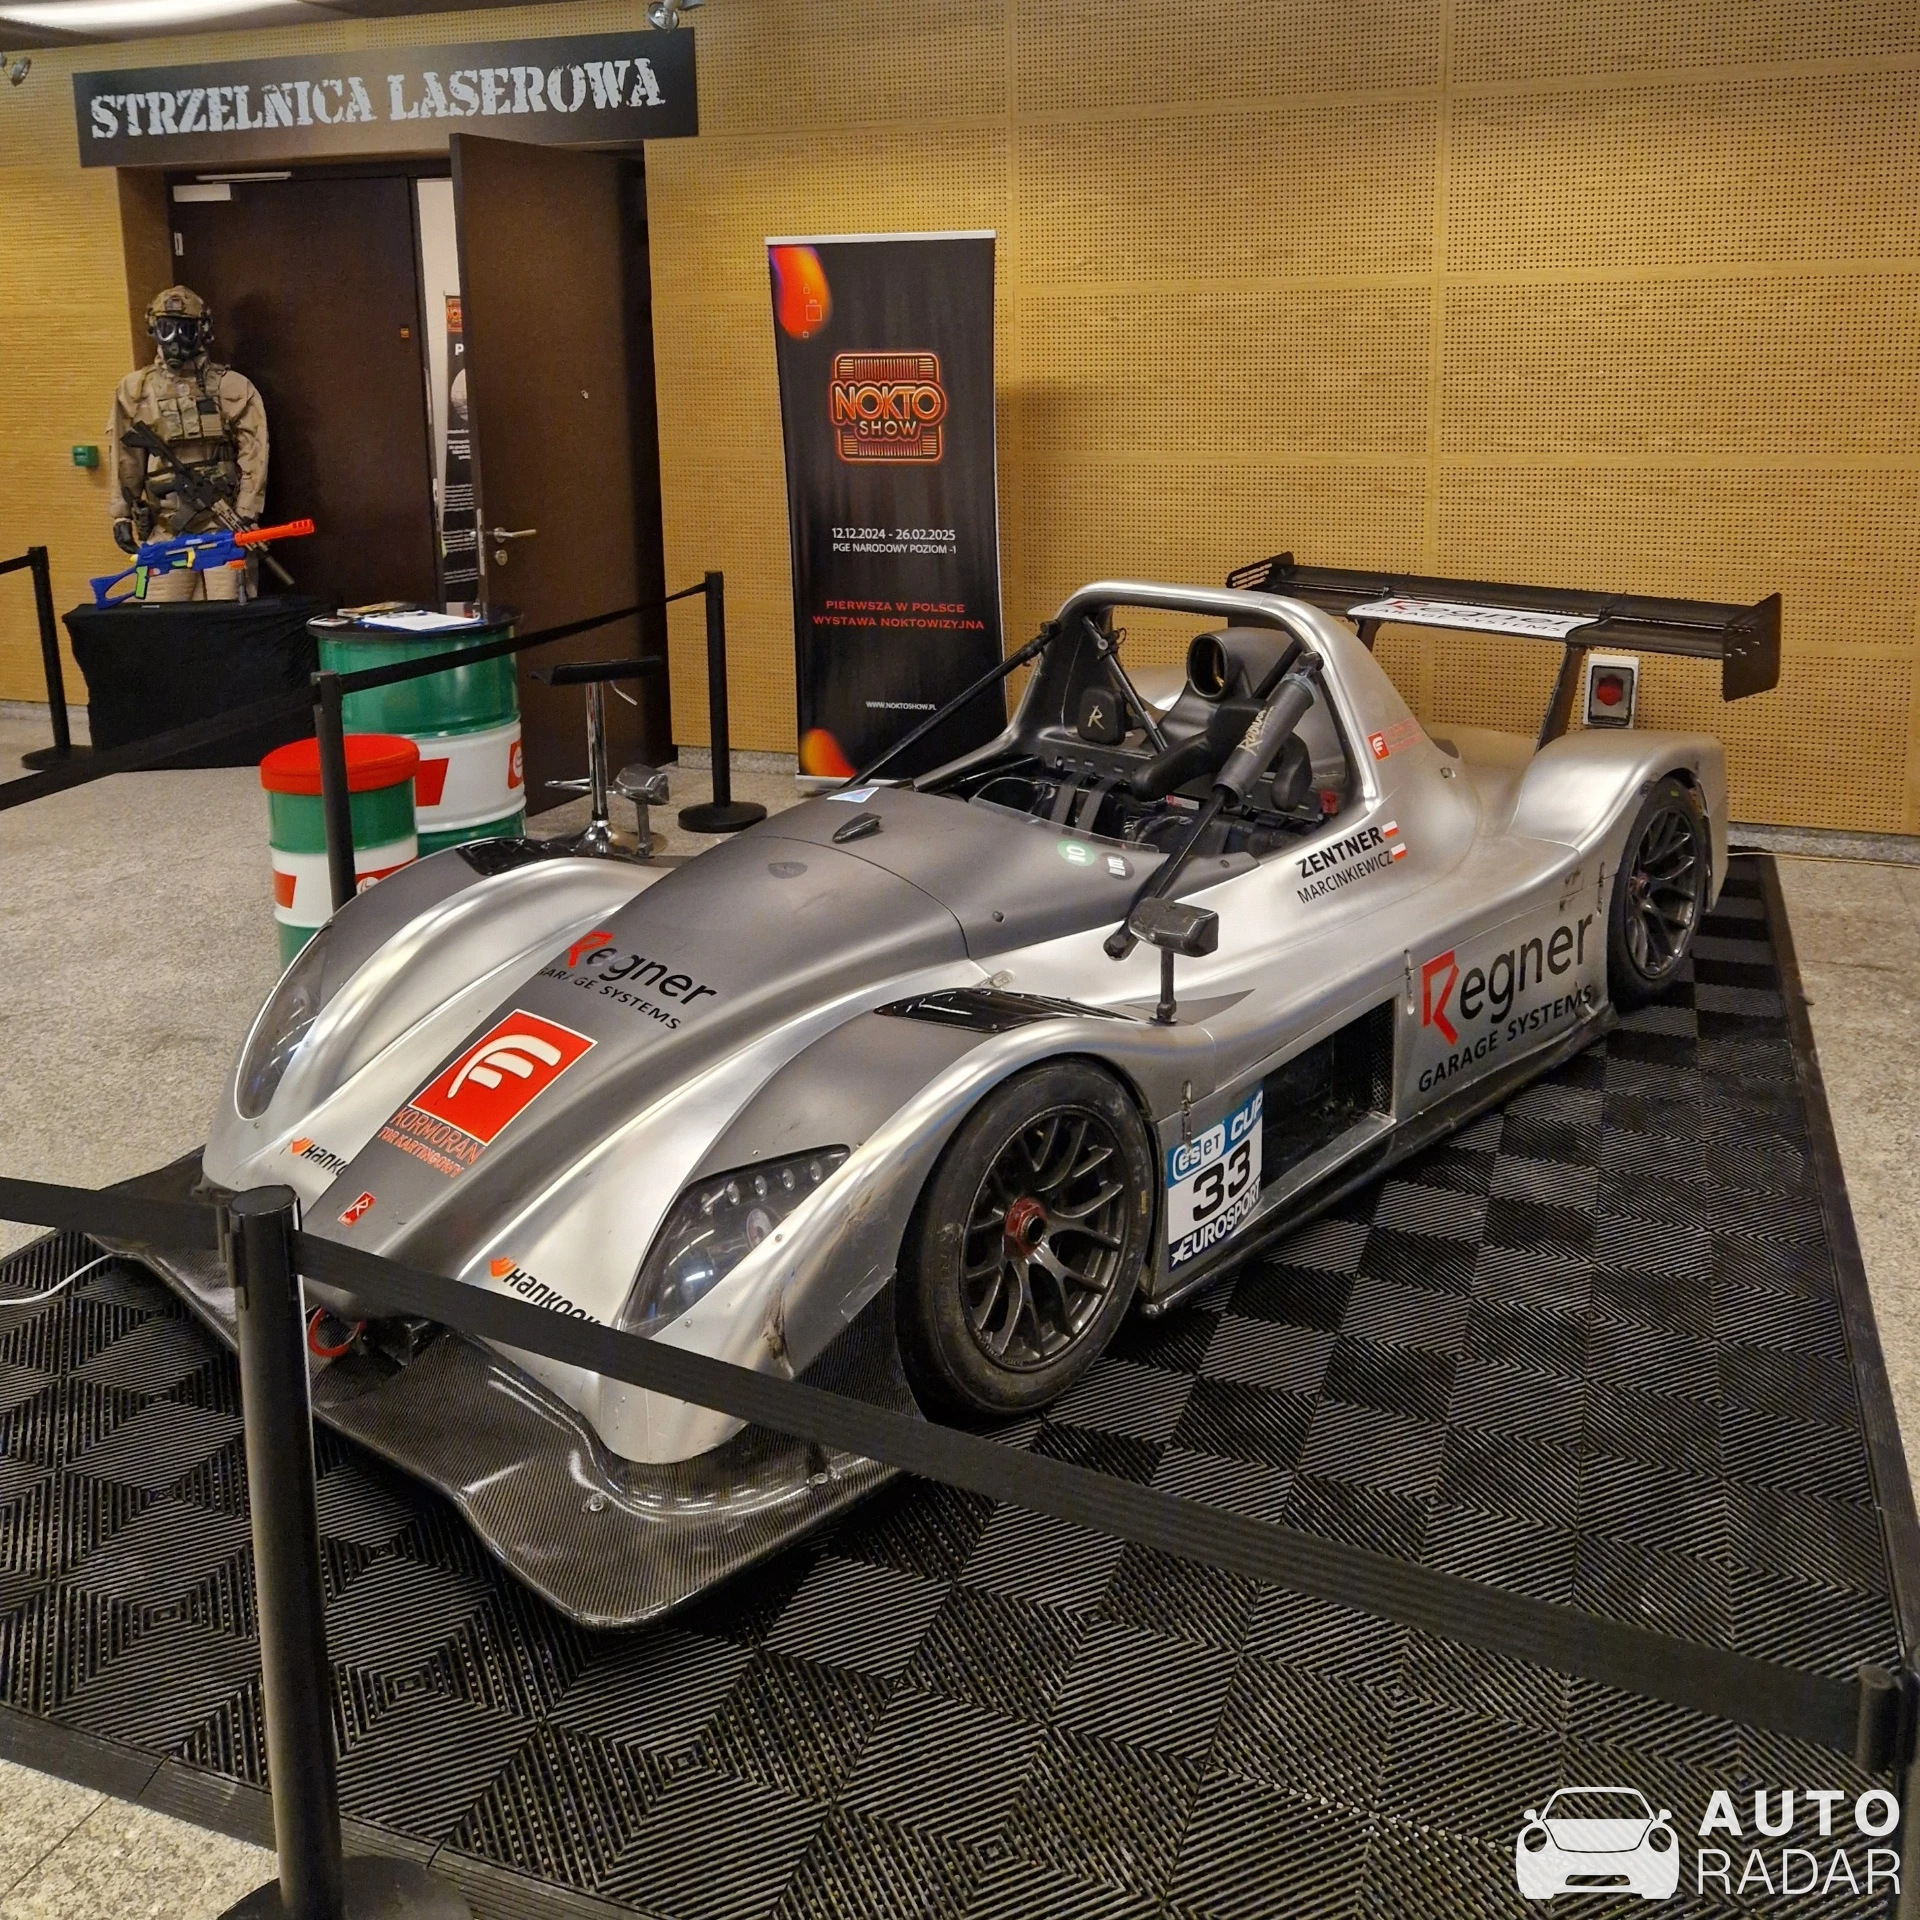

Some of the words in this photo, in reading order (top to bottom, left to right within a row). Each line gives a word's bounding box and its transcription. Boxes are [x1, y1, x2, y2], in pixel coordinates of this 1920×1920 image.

[91, 75, 377, 138] STRZELNICA
[387, 57, 667, 121] LASEROWA
[834, 385, 942, 421] NOKTO
[858, 420, 917, 436] SHOW
[831, 527, 886, 540] 12.12.2024
[895, 528, 956, 541] 26.02.2025
[832, 542, 851, 552] PGE
[852, 543, 908, 553] NARODOWY
[909, 544, 947, 554] POZIOM
[949, 545, 957, 555] -1
[812, 616, 877, 627] WYSTAWA
[880, 617, 985, 630] NOKTOWIZYJNA
[825, 600, 892, 611] PIERWSZA
[895, 602, 908, 612] W
[912, 602, 965, 613] POLSCE
[865, 700, 937, 711] WWW.NOKTOSHOW.PL
[1295, 826, 1385, 879] ZENTNER
[1296, 850, 1394, 904] MARCINKIEWICZ
[567, 930, 717, 1005] Regner
[1421, 913, 1593, 1047] Regner
[599, 985, 681, 1030] SYSTEMS
[1418, 1030, 1499, 1093] GARAGE
[1507, 984, 1593, 1042] SYSTEMS
[389, 1106, 486, 1165] KORMORAN
[1230, 1089, 1264, 1142] CUP
[377, 1126, 400, 1144] TOR
[394, 1133, 466, 1178] KARTINGOWY
[1192, 1139, 1250, 1222] 33
[1179, 1175, 1261, 1262] EUROSPORT
